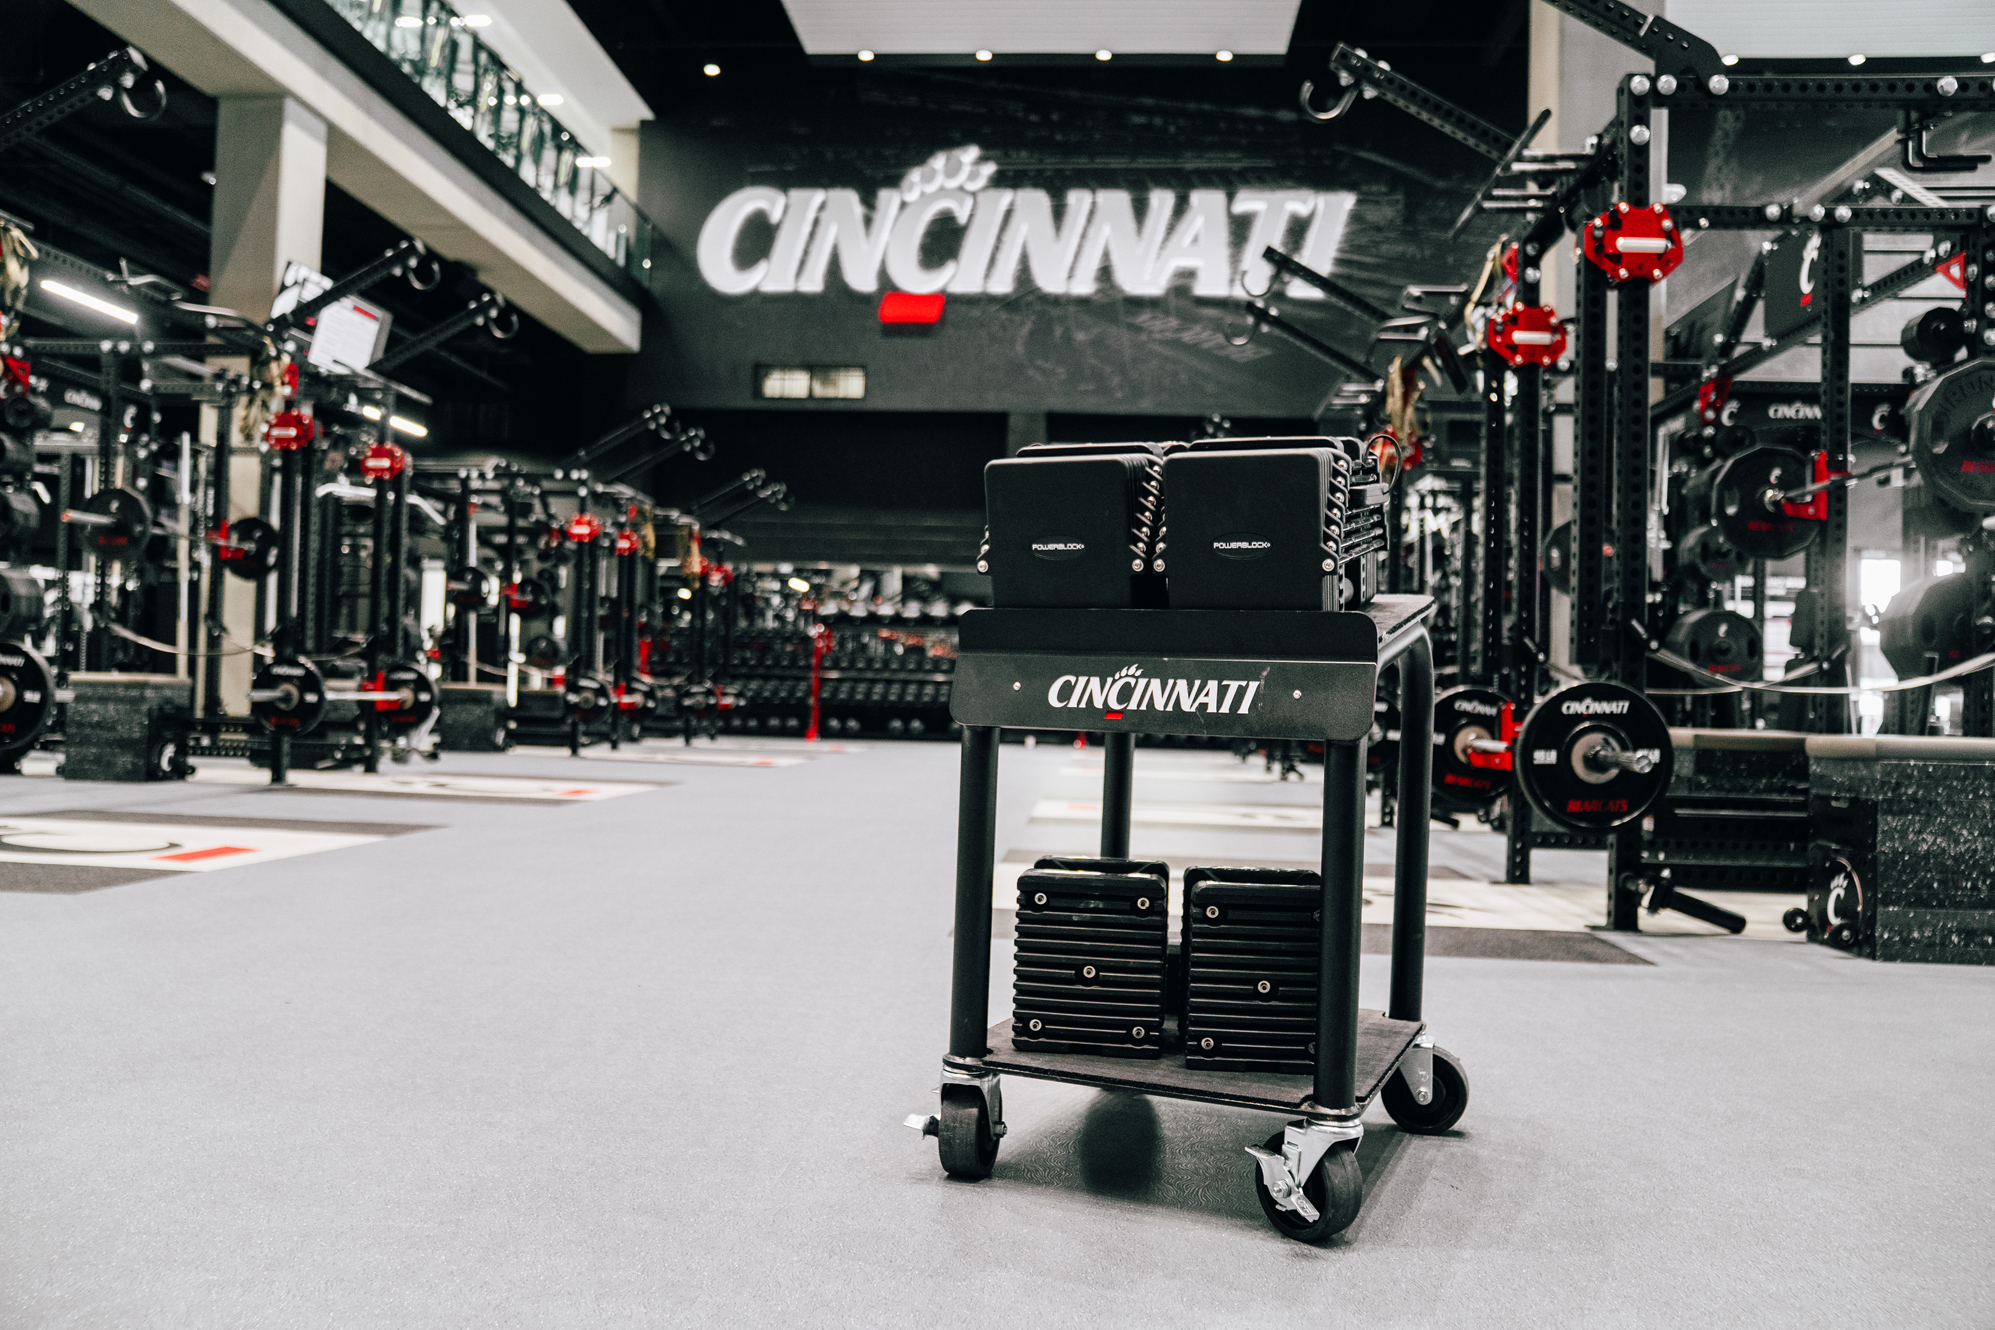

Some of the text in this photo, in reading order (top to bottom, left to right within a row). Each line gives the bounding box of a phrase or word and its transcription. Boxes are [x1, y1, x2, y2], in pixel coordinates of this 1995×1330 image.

[698, 183, 1356, 297] CINCINNATI
[1047, 674, 1261, 714] CINCINNATI
[1562, 699, 1631, 714] CINCINNATI
[1567, 800, 1629, 812] BEARCATS
